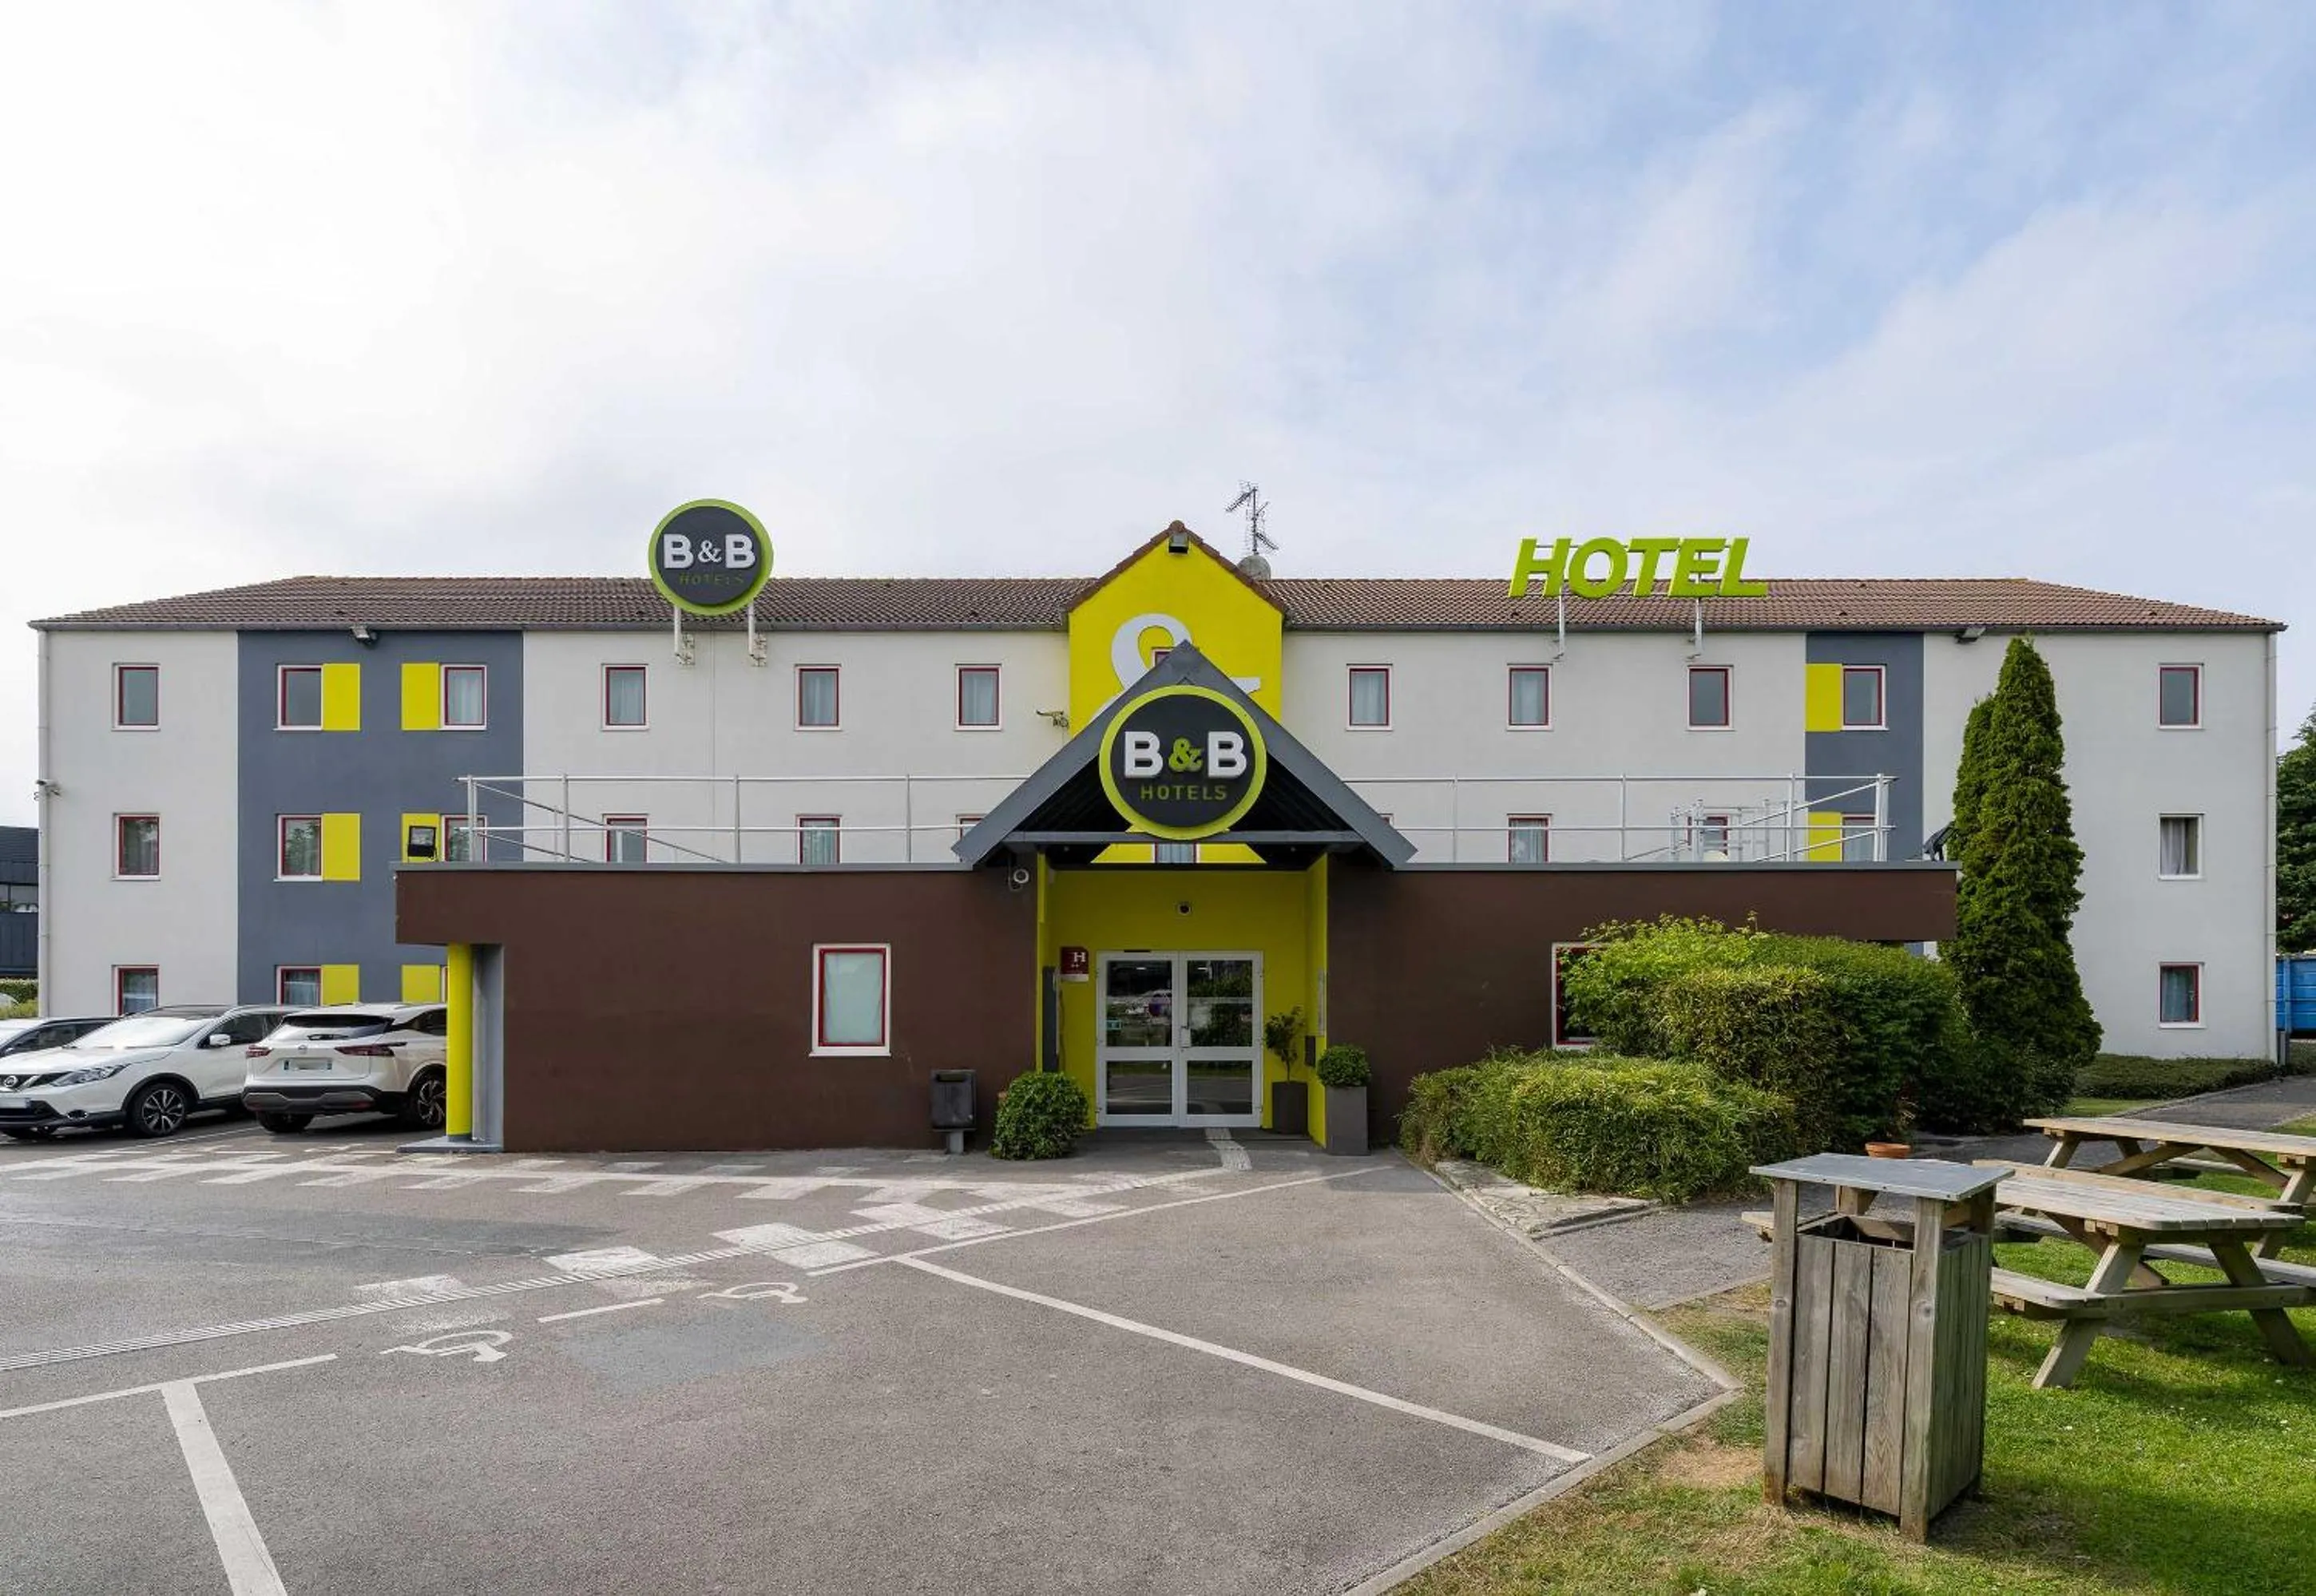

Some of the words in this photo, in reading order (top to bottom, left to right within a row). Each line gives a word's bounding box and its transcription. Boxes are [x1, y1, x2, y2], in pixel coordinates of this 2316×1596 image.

[663, 533, 755, 569] B&B
[1507, 537, 1768, 599] HOTEL
[1124, 731, 1247, 779] B&B
[1140, 784, 1228, 801] HOTELS
[1073, 952, 1086, 962] H
